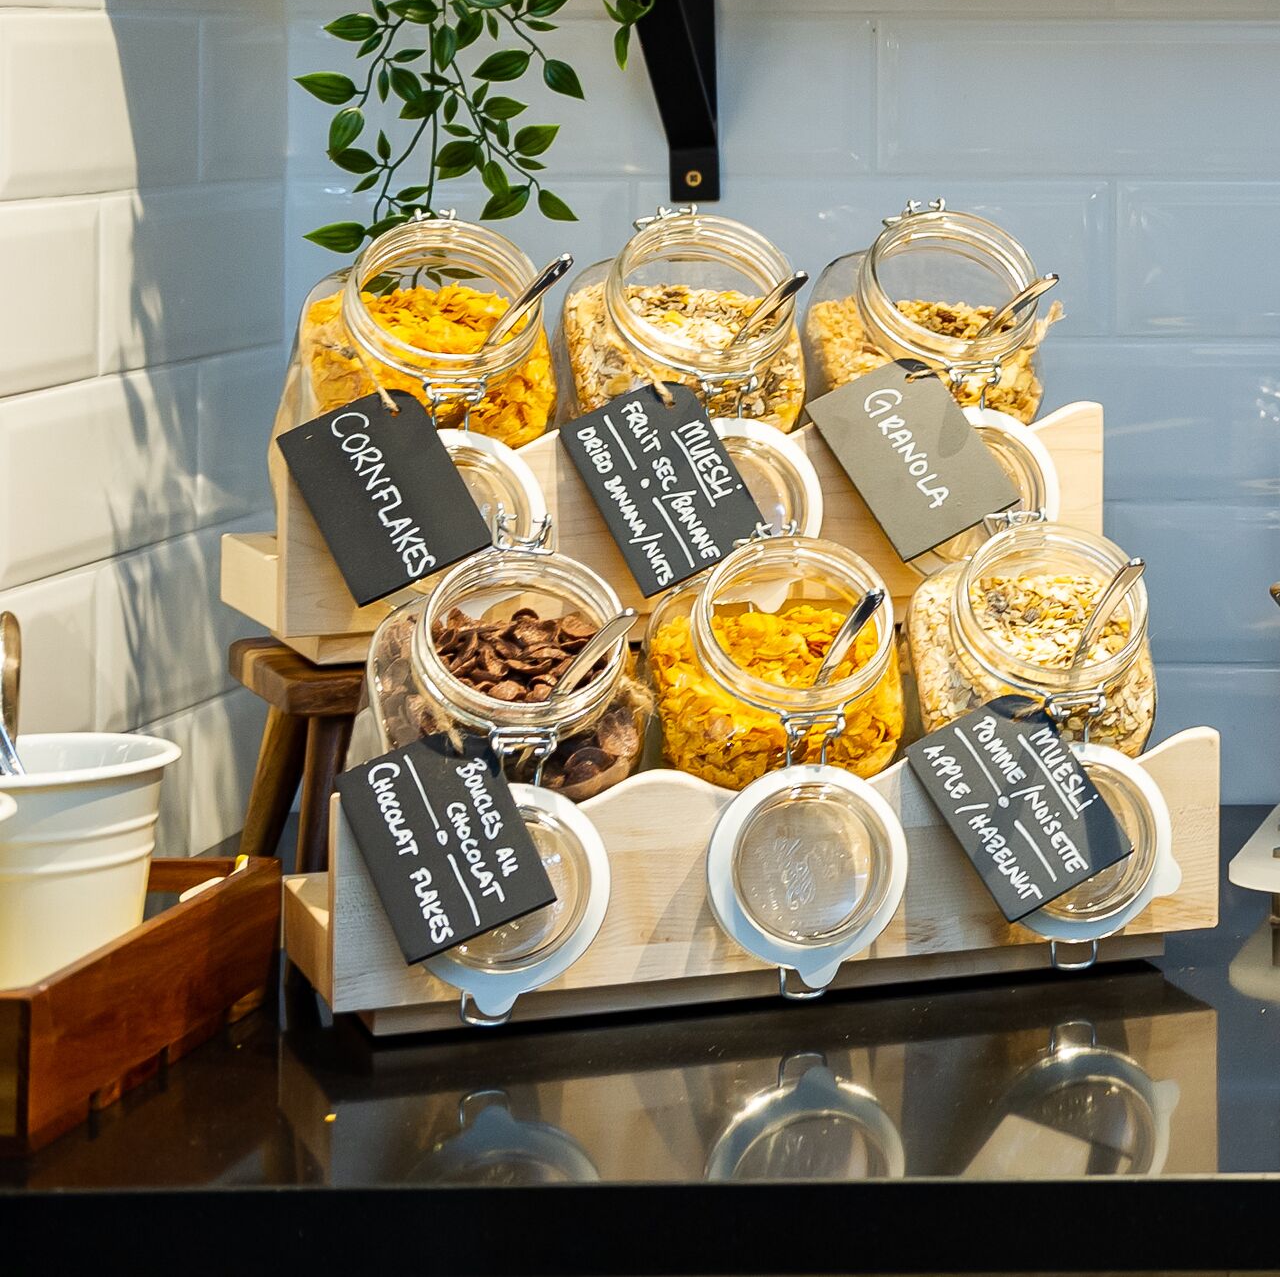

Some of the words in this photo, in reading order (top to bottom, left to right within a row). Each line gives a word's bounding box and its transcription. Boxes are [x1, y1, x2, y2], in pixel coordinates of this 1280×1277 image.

[330, 411, 437, 578] CORNFLAKES
[863, 388, 950, 509] GRANOLA
[455, 756, 504, 841] BOUCLES
[495, 847, 519, 878] AU
[922, 744, 972, 800] APPLE
[367, 762, 419, 856] CHOCOLAT
[409, 867, 455, 944] FLAKES
[446, 801, 506, 904] CHOCOLAT
